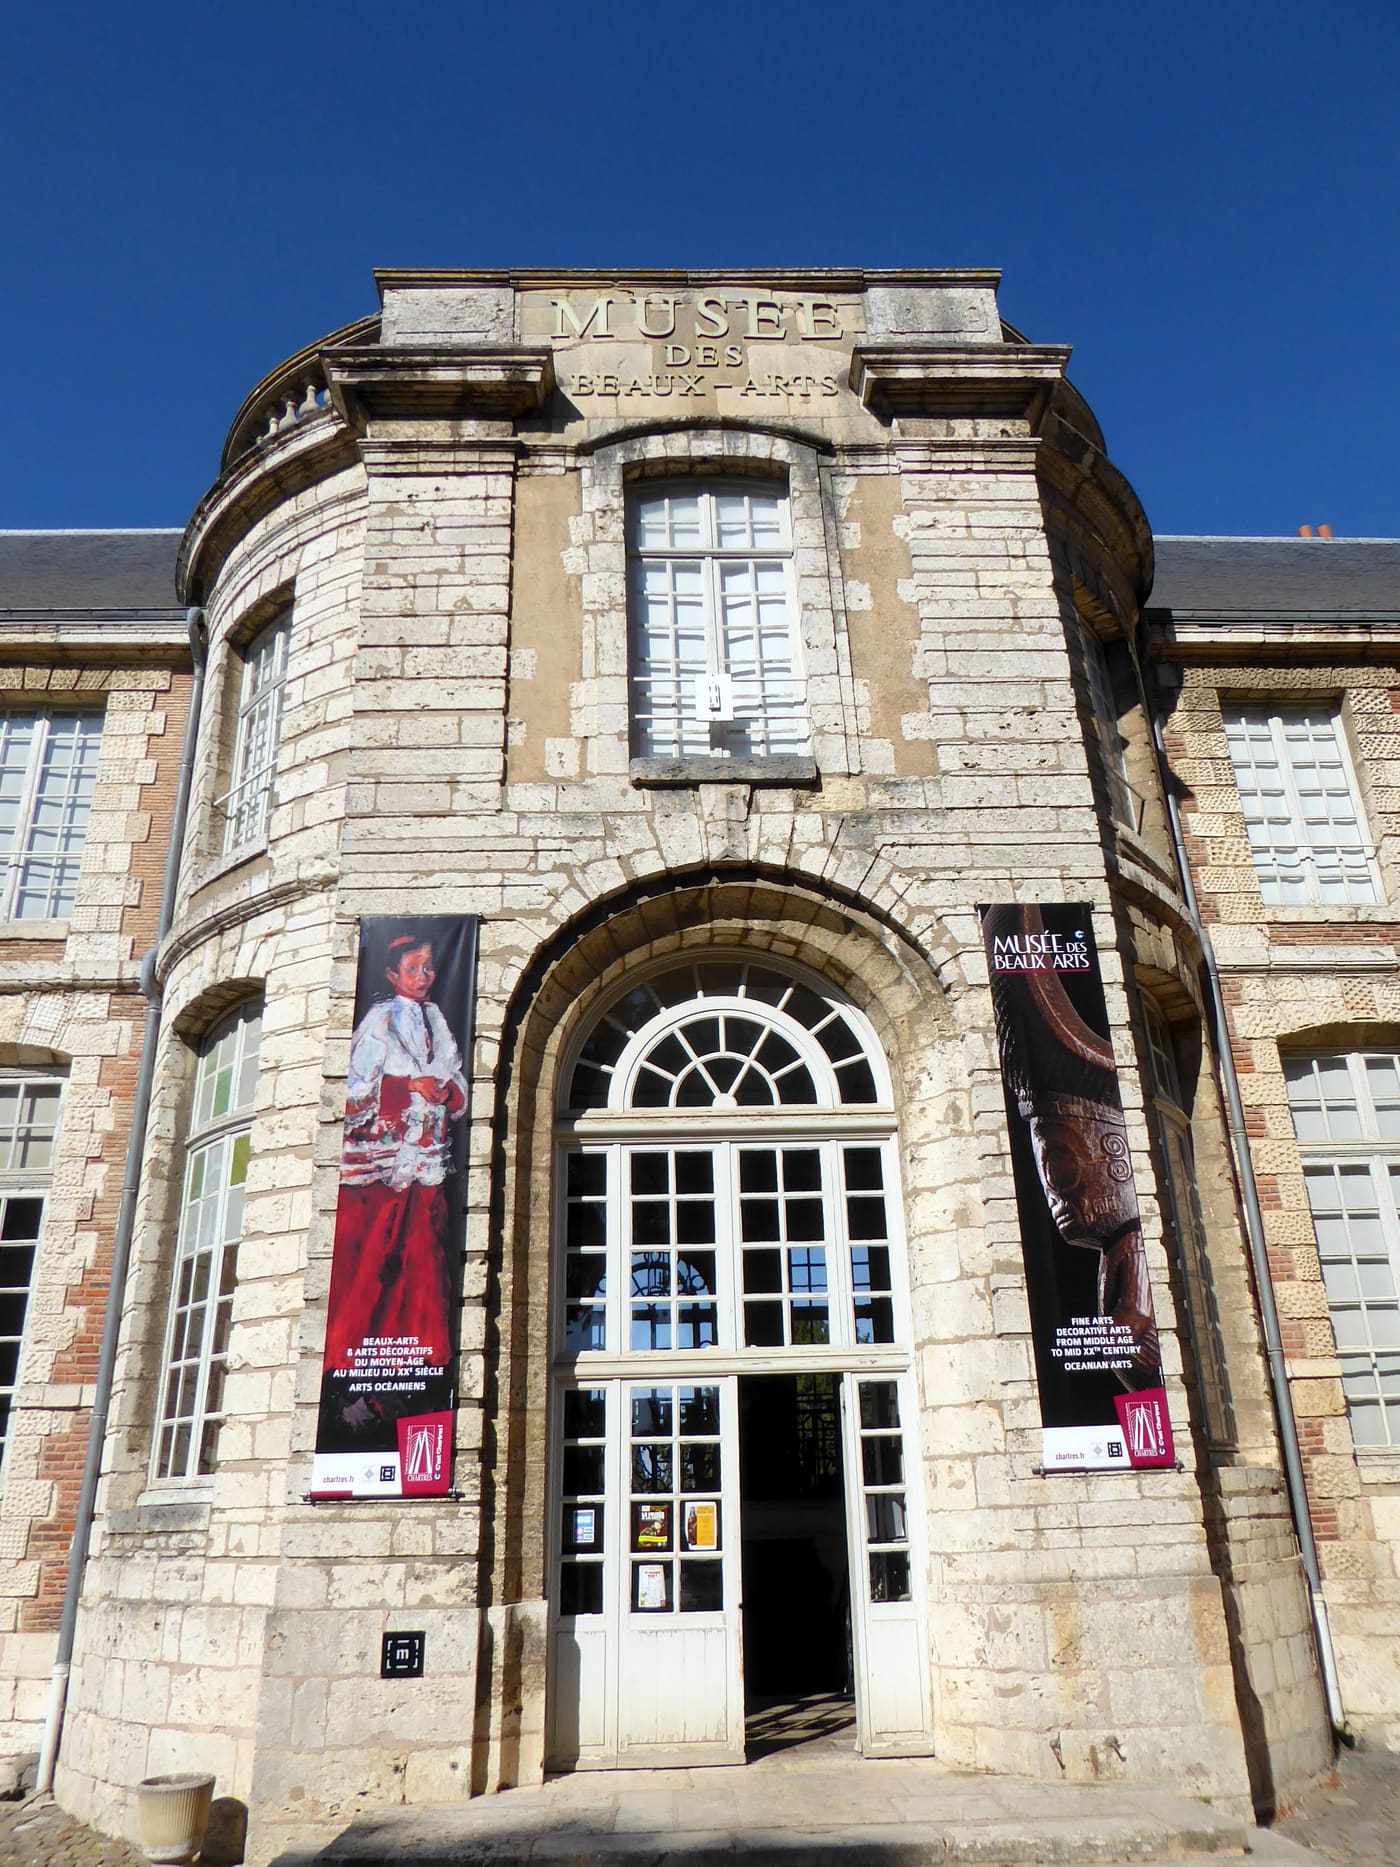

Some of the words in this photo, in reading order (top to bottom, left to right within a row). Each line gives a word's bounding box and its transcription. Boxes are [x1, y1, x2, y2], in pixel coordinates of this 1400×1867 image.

[550, 297, 844, 341] MUSEE
[664, 344, 743, 367] DES
[993, 930, 1065, 954] MUSÉE
[1066, 942, 1088, 953] DES
[994, 954, 1046, 969] BEAUX
[1053, 953, 1090, 968] ARTS
[1071, 1317, 1090, 1325] FINE
[1092, 1316, 1114, 1325] ARTS
[1056, 1326, 1108, 1337] DECORATIVE
[1109, 1325, 1131, 1334] ARTS
[363, 1337, 419, 1346] BEAUX-ARTS
[1056, 1338, 1082, 1347] FROM
[1083, 1336, 1115, 1346] MIDDLE
[1117, 1336, 1134, 1344] AGE
[347, 1348, 353, 1356] &
[354, 1347, 378, 1356] ARTS
[380, 1346, 433, 1356] DÉCORATIFS
[1051, 1348, 1063, 1357] TO
[1064, 1347, 1082, 1357] MID
[1102, 1345, 1141, 1355] CENTURY
[354, 1358, 369, 1367] DU
[370, 1356, 424, 1367] MOYEN-ÂGE
[1064, 1361, 1109, 1371] OCEANIAN
[1110, 1360, 1133, 1369] ARTS
[333, 1368, 348, 1377] AU
[349, 1368, 381, 1377] MILIEU
[382, 1368, 396, 1377] DU
[414, 1366, 444, 1376] SIÈCLE
[349, 1383, 372, 1392] ARTS
[375, 1381, 426, 1391] OCÉANIENS
[1055, 1452, 1085, 1461] chartres.fr
[323, 1476, 354, 1484] chartres.fr
[396, 1648, 409, 1660] m
